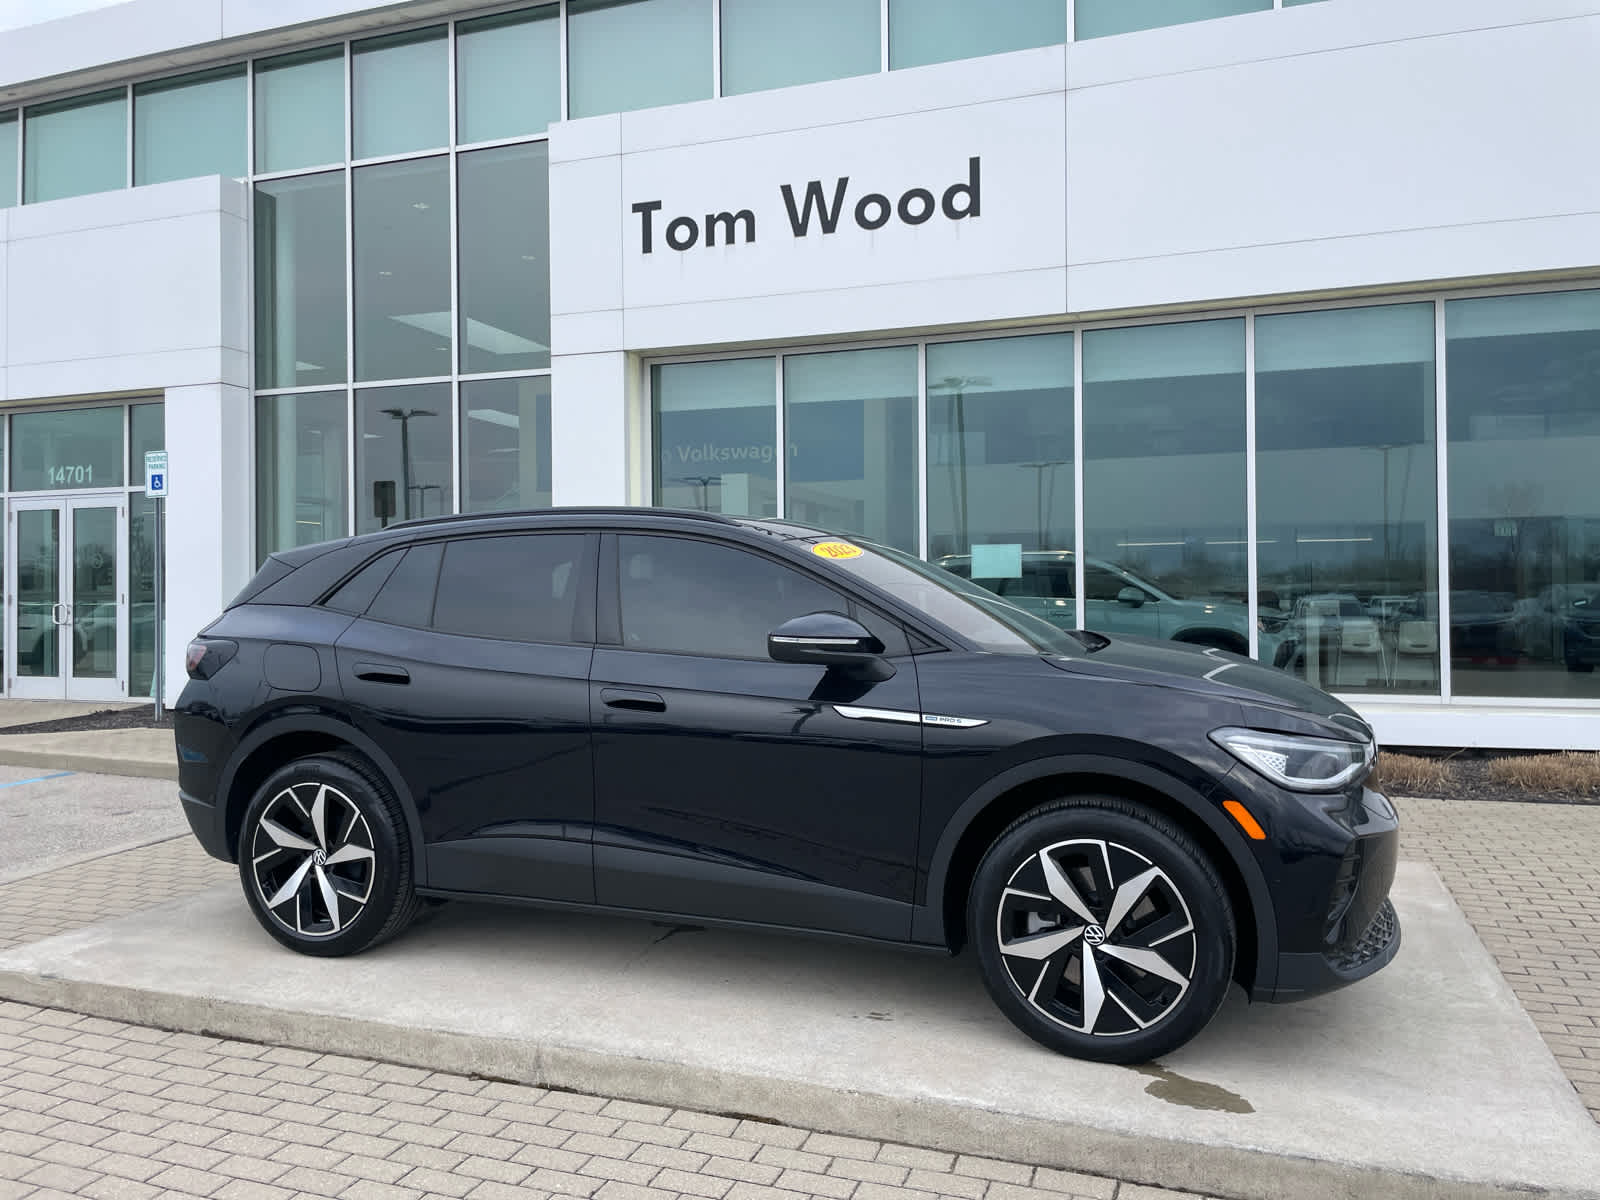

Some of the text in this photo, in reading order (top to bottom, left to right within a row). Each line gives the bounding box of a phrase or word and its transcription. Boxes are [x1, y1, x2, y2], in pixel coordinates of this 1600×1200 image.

[632, 156, 981, 254] Tom Wood
[677, 442, 798, 464] Volkswagn
[49, 464, 92, 485] 14701
